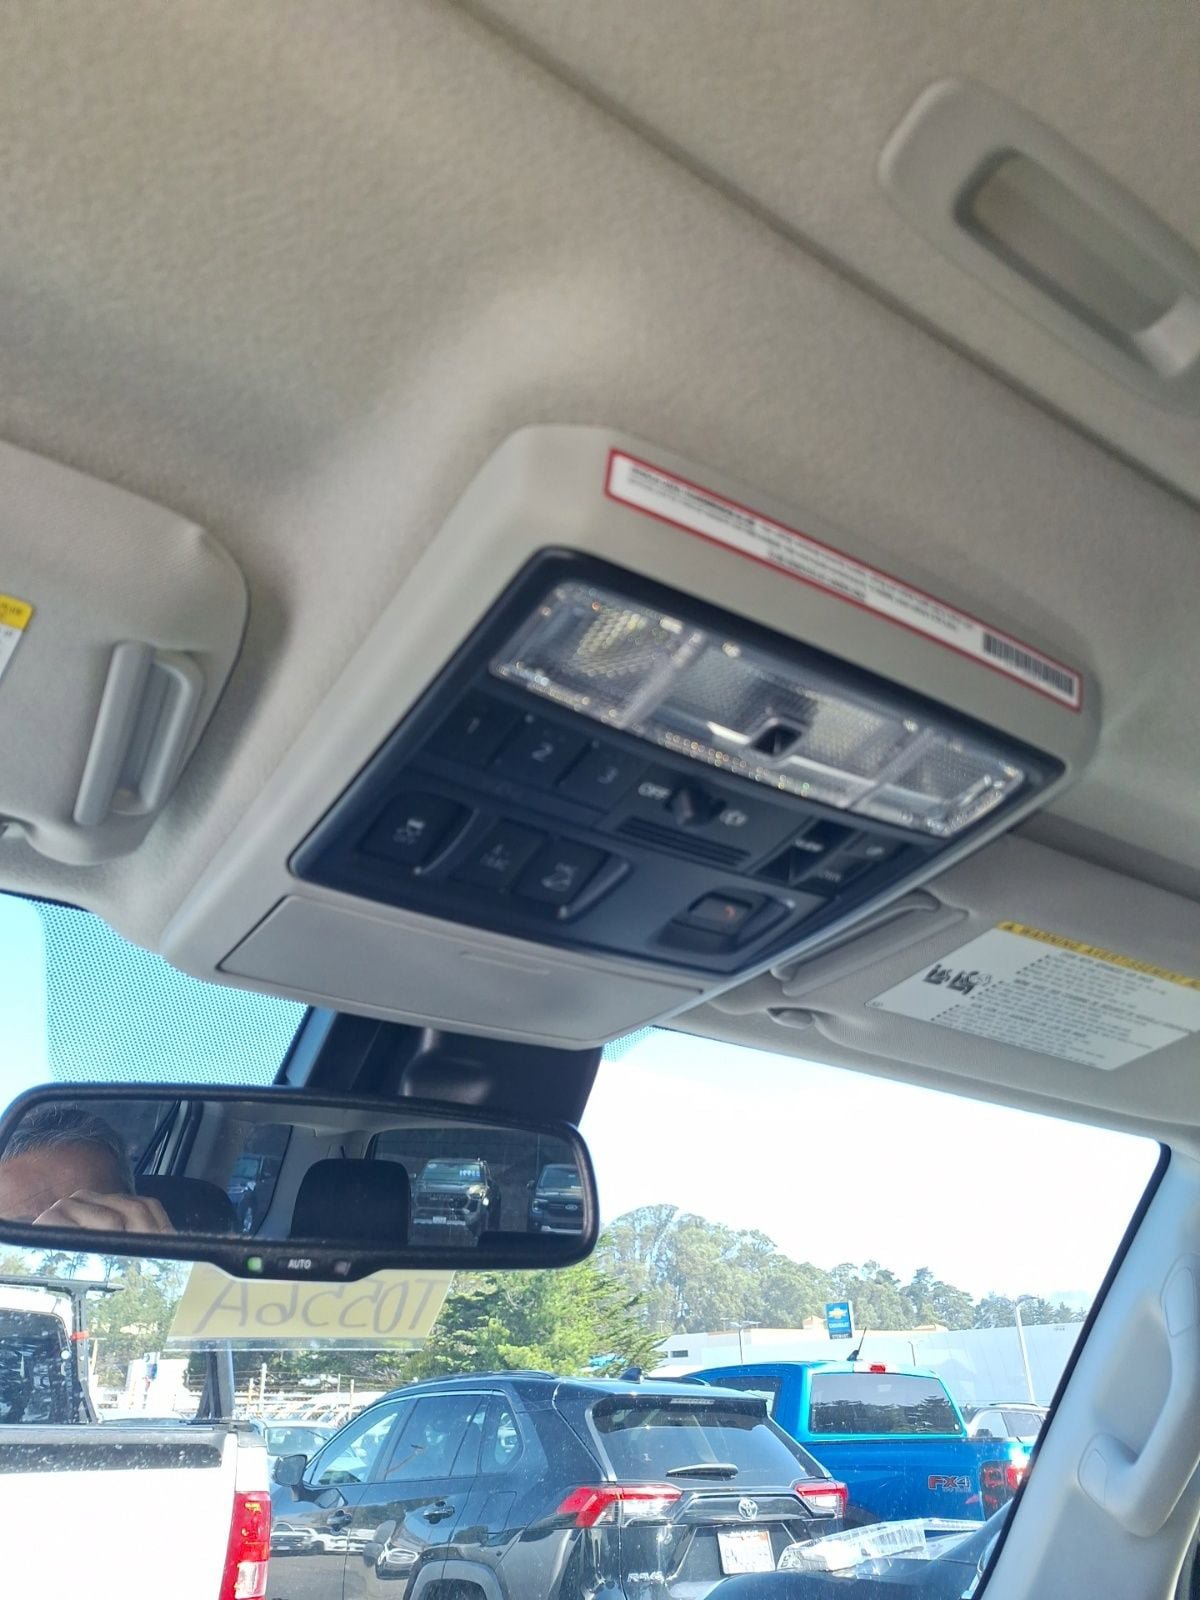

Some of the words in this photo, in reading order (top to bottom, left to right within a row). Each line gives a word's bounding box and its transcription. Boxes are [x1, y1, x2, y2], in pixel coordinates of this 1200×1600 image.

[531, 742, 554, 761] 2
[596, 767, 619, 785] 3
[288, 1259, 311, 1270] AUTO
[928, 1474, 971, 1491] FX4
